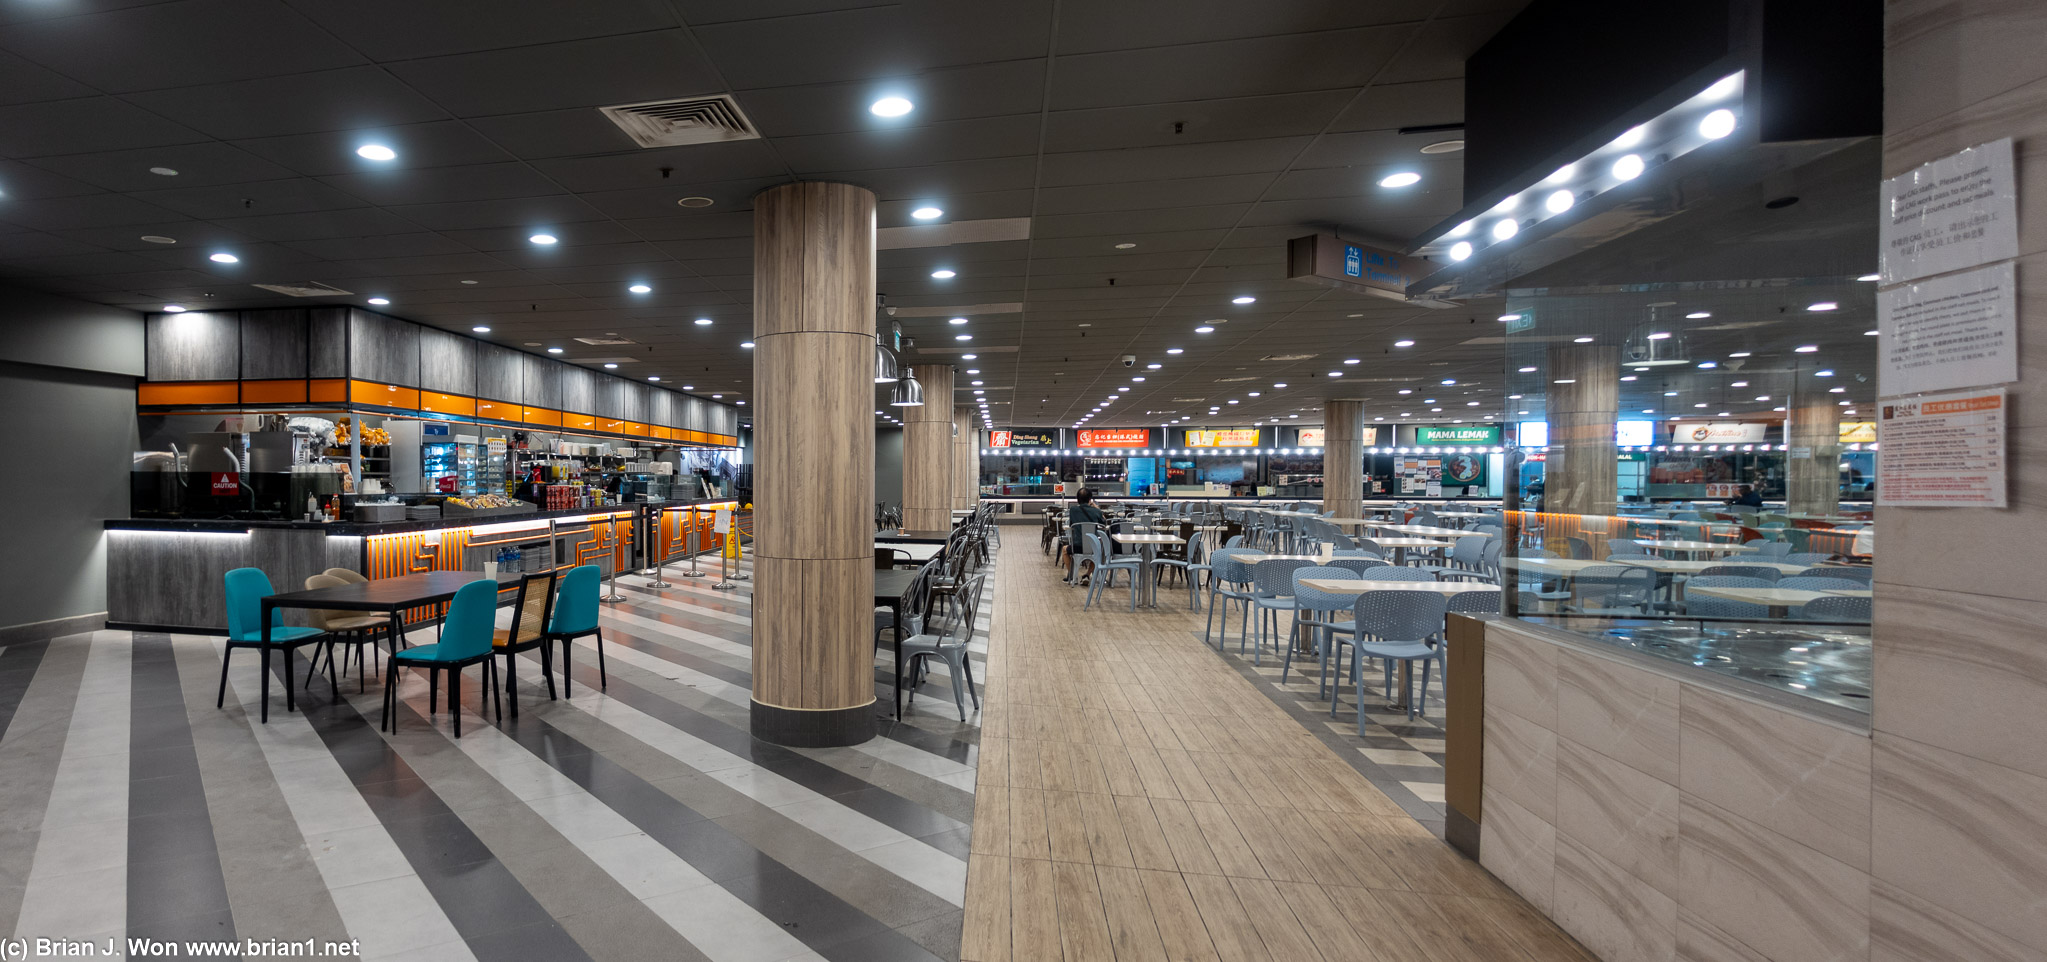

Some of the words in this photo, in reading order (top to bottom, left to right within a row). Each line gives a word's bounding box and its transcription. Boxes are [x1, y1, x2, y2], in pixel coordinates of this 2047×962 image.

[1939, 175, 1961, 186] Please
[1963, 166, 1989, 180] present
[1916, 194, 1933, 207] work
[1950, 186, 1959, 196] to
[1960, 181, 1979, 195] enjoy
[1979, 176, 1992, 187] the
[1946, 197, 1961, 209] and
[1366, 252, 1384, 267] Lifts
[1366, 267, 1401, 287] Terminal
[1427, 431, 1455, 439] MAMA
[1457, 430, 1489, 439] LEMAK
